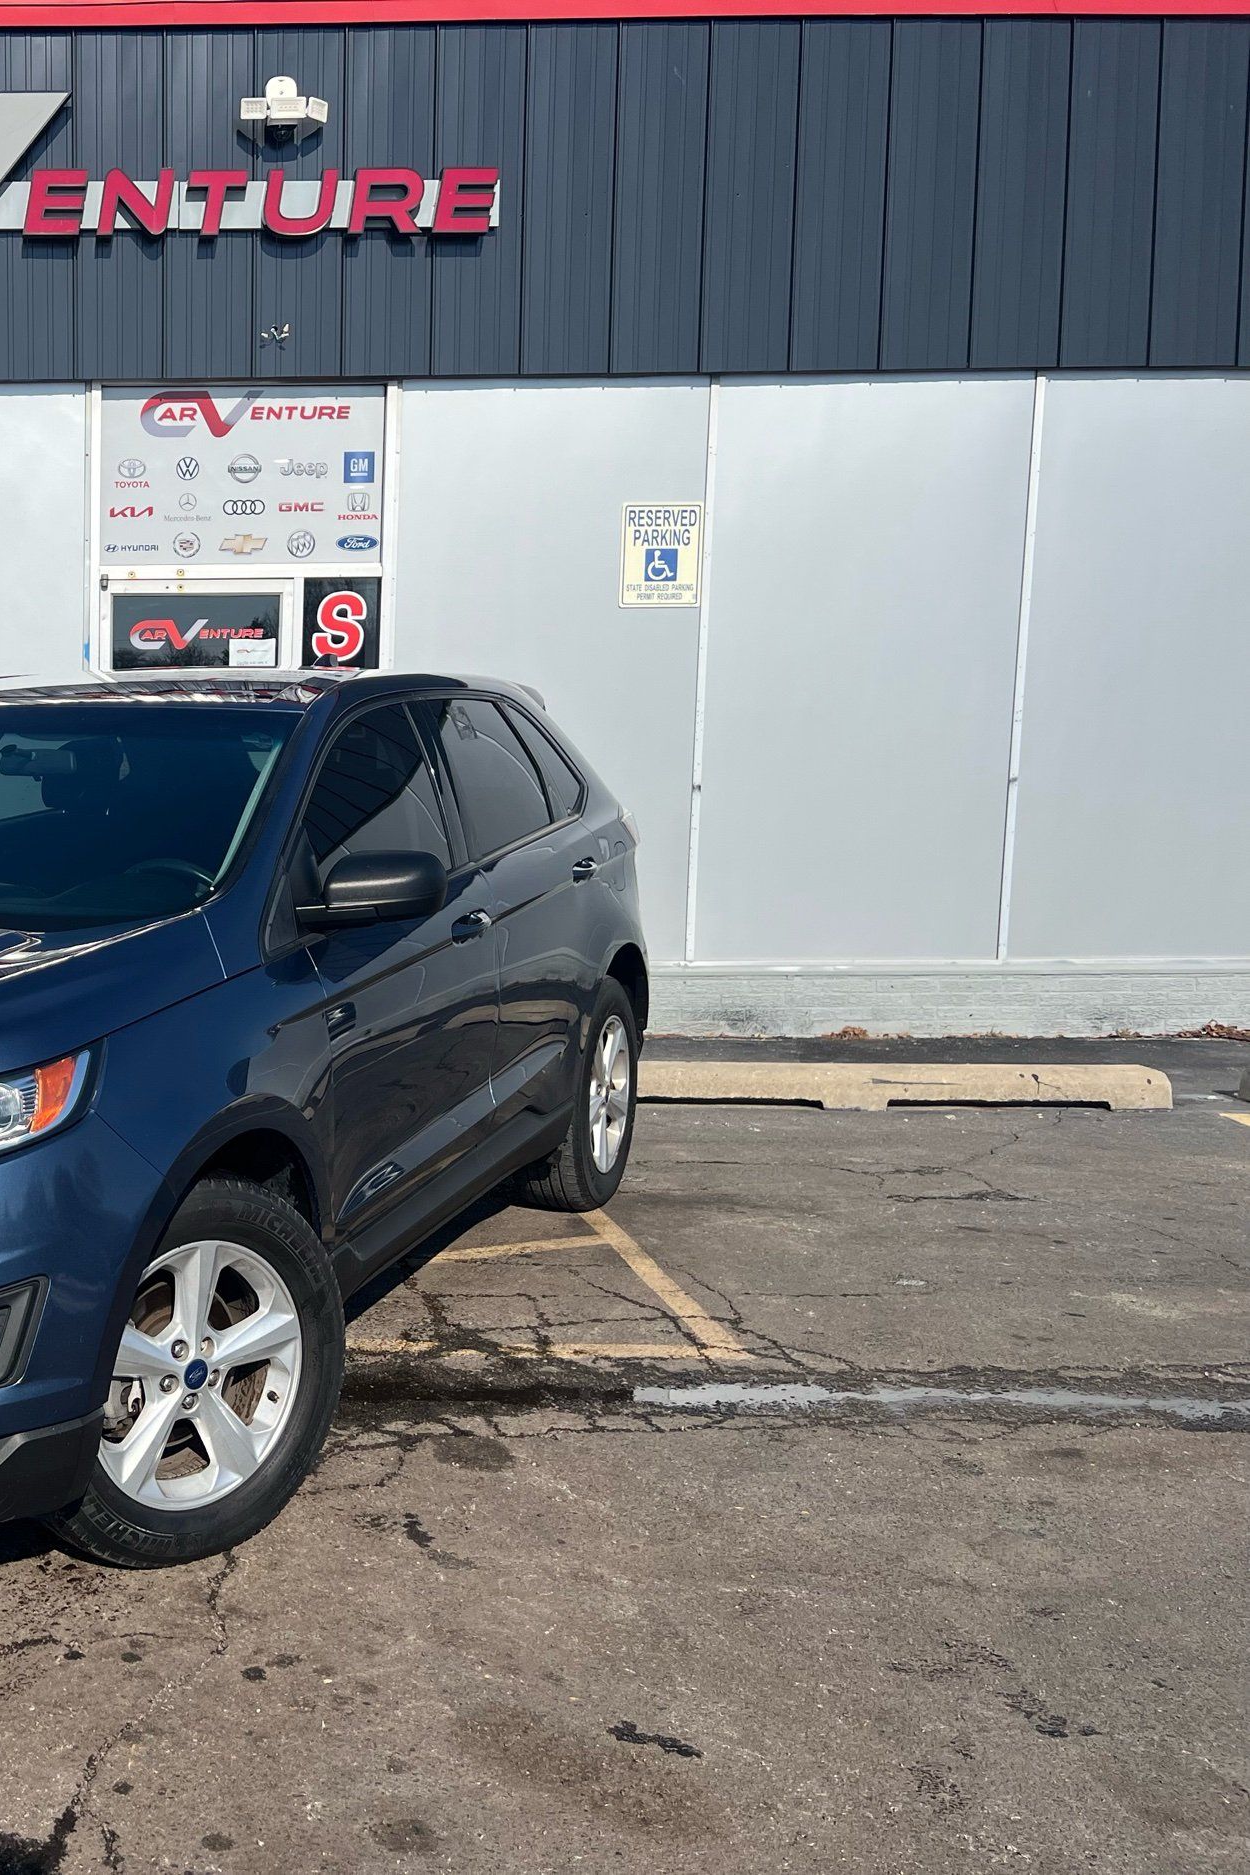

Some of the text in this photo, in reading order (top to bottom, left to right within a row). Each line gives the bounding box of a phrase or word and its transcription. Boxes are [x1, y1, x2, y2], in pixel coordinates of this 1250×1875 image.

[279, 458, 328, 478] Jeep
[350, 458, 368, 472] GM
[114, 481, 150, 489] TOYOTA
[110, 506, 154, 518] KIA
[278, 502, 324, 512] GMC
[628, 509, 697, 527] RESERVED
[343, 536, 371, 549] Ford
[633, 529, 691, 547] PARKING
[120, 544, 159, 552] HYUNDAI
[626, 584, 694, 592] STATE DISABLED PARKING
[636, 593, 655, 601] PERMIT
[312, 591, 367, 661] S
